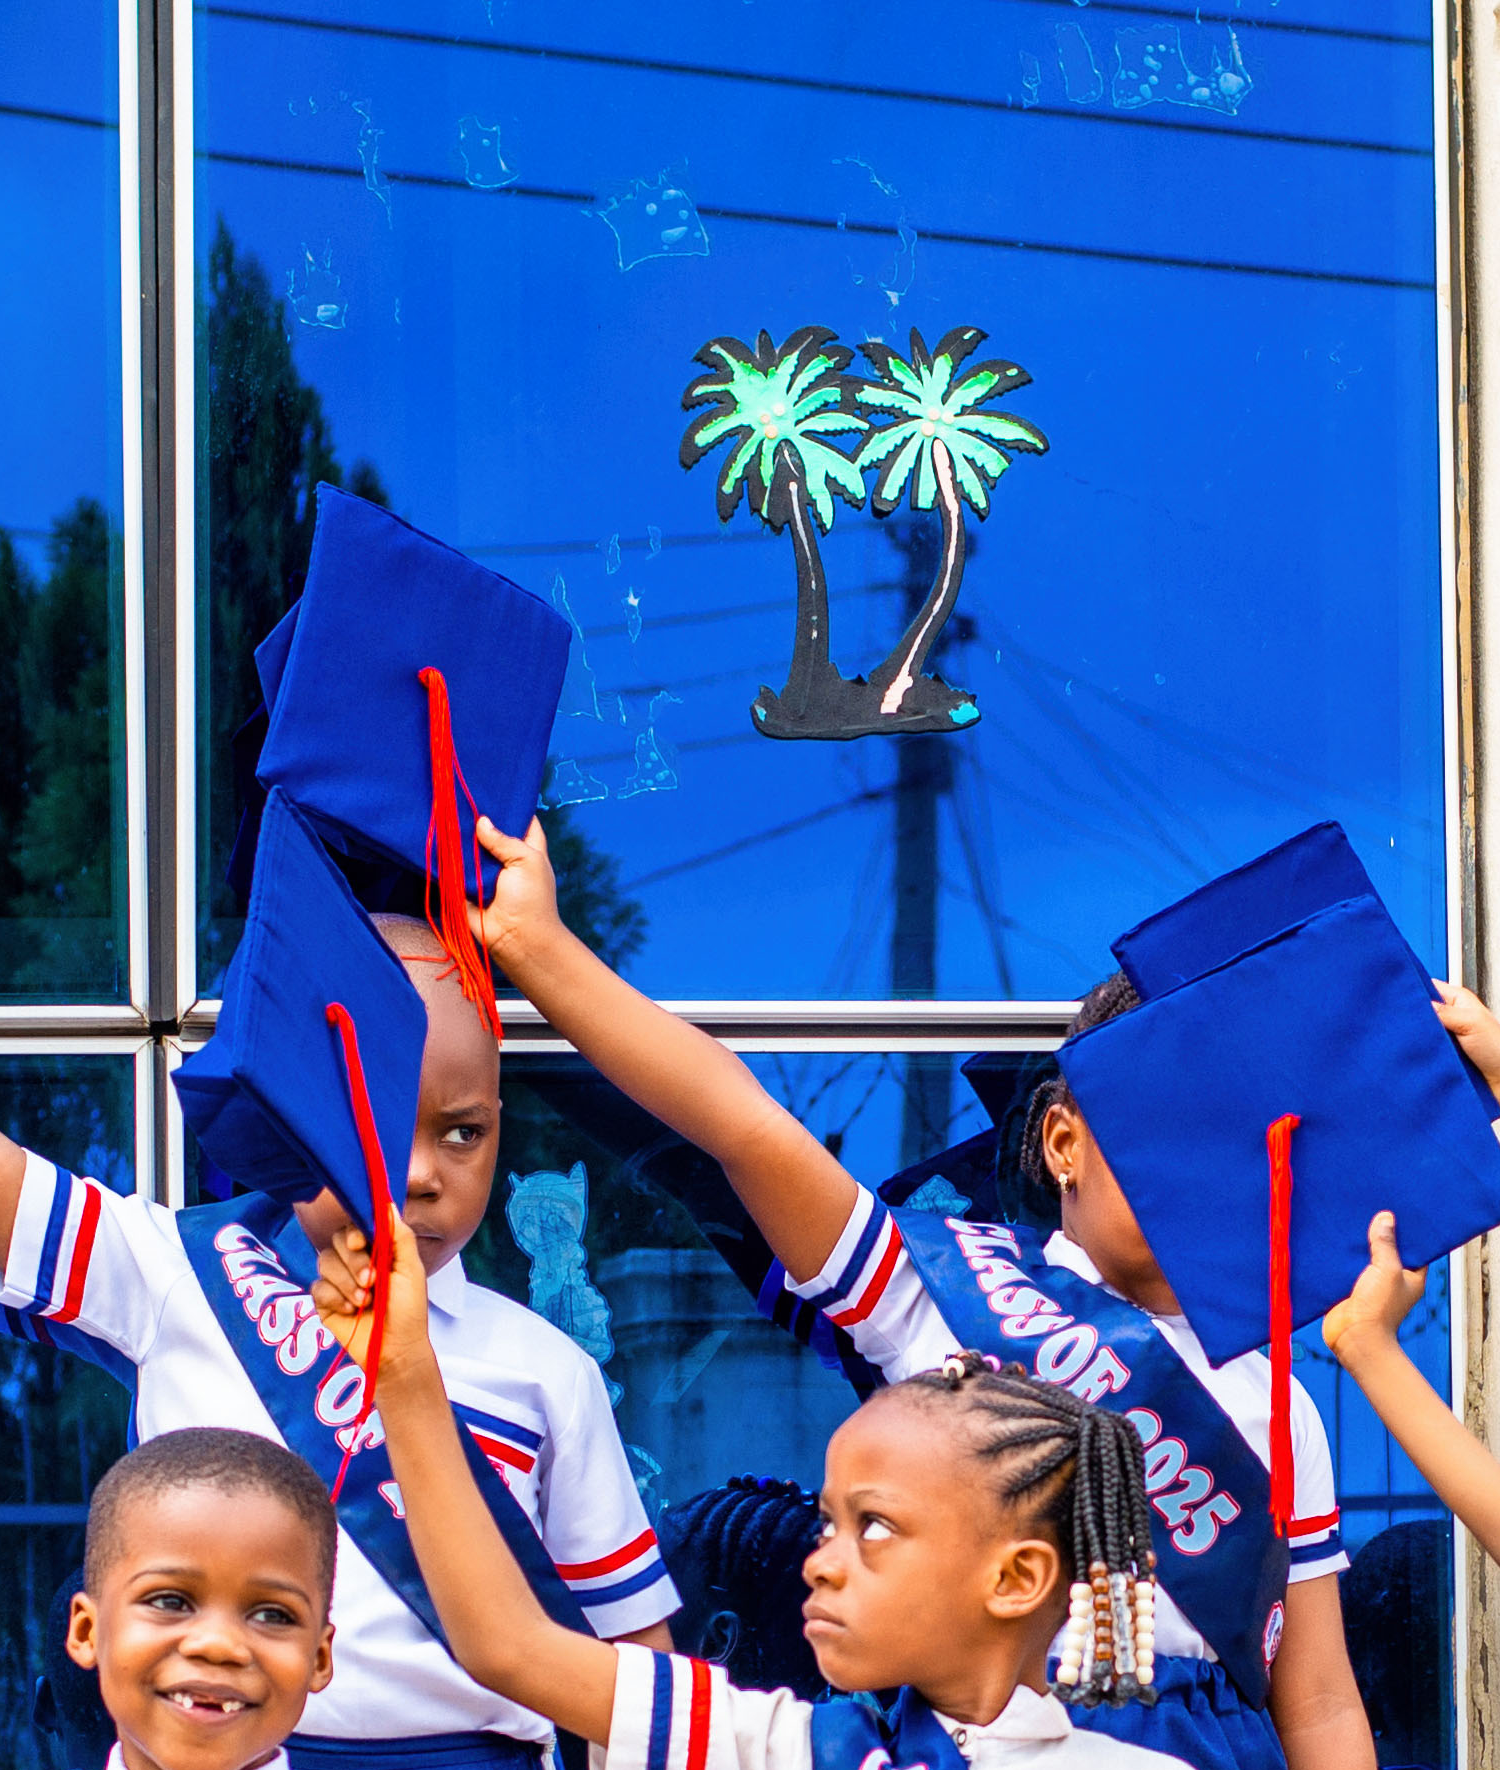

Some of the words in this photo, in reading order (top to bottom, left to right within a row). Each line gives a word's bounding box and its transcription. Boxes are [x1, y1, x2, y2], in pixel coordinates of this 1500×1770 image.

[214, 1222, 336, 1376] CLASS
[944, 1216, 1075, 1338] CLASS
[1034, 1323, 1131, 1404] OF
